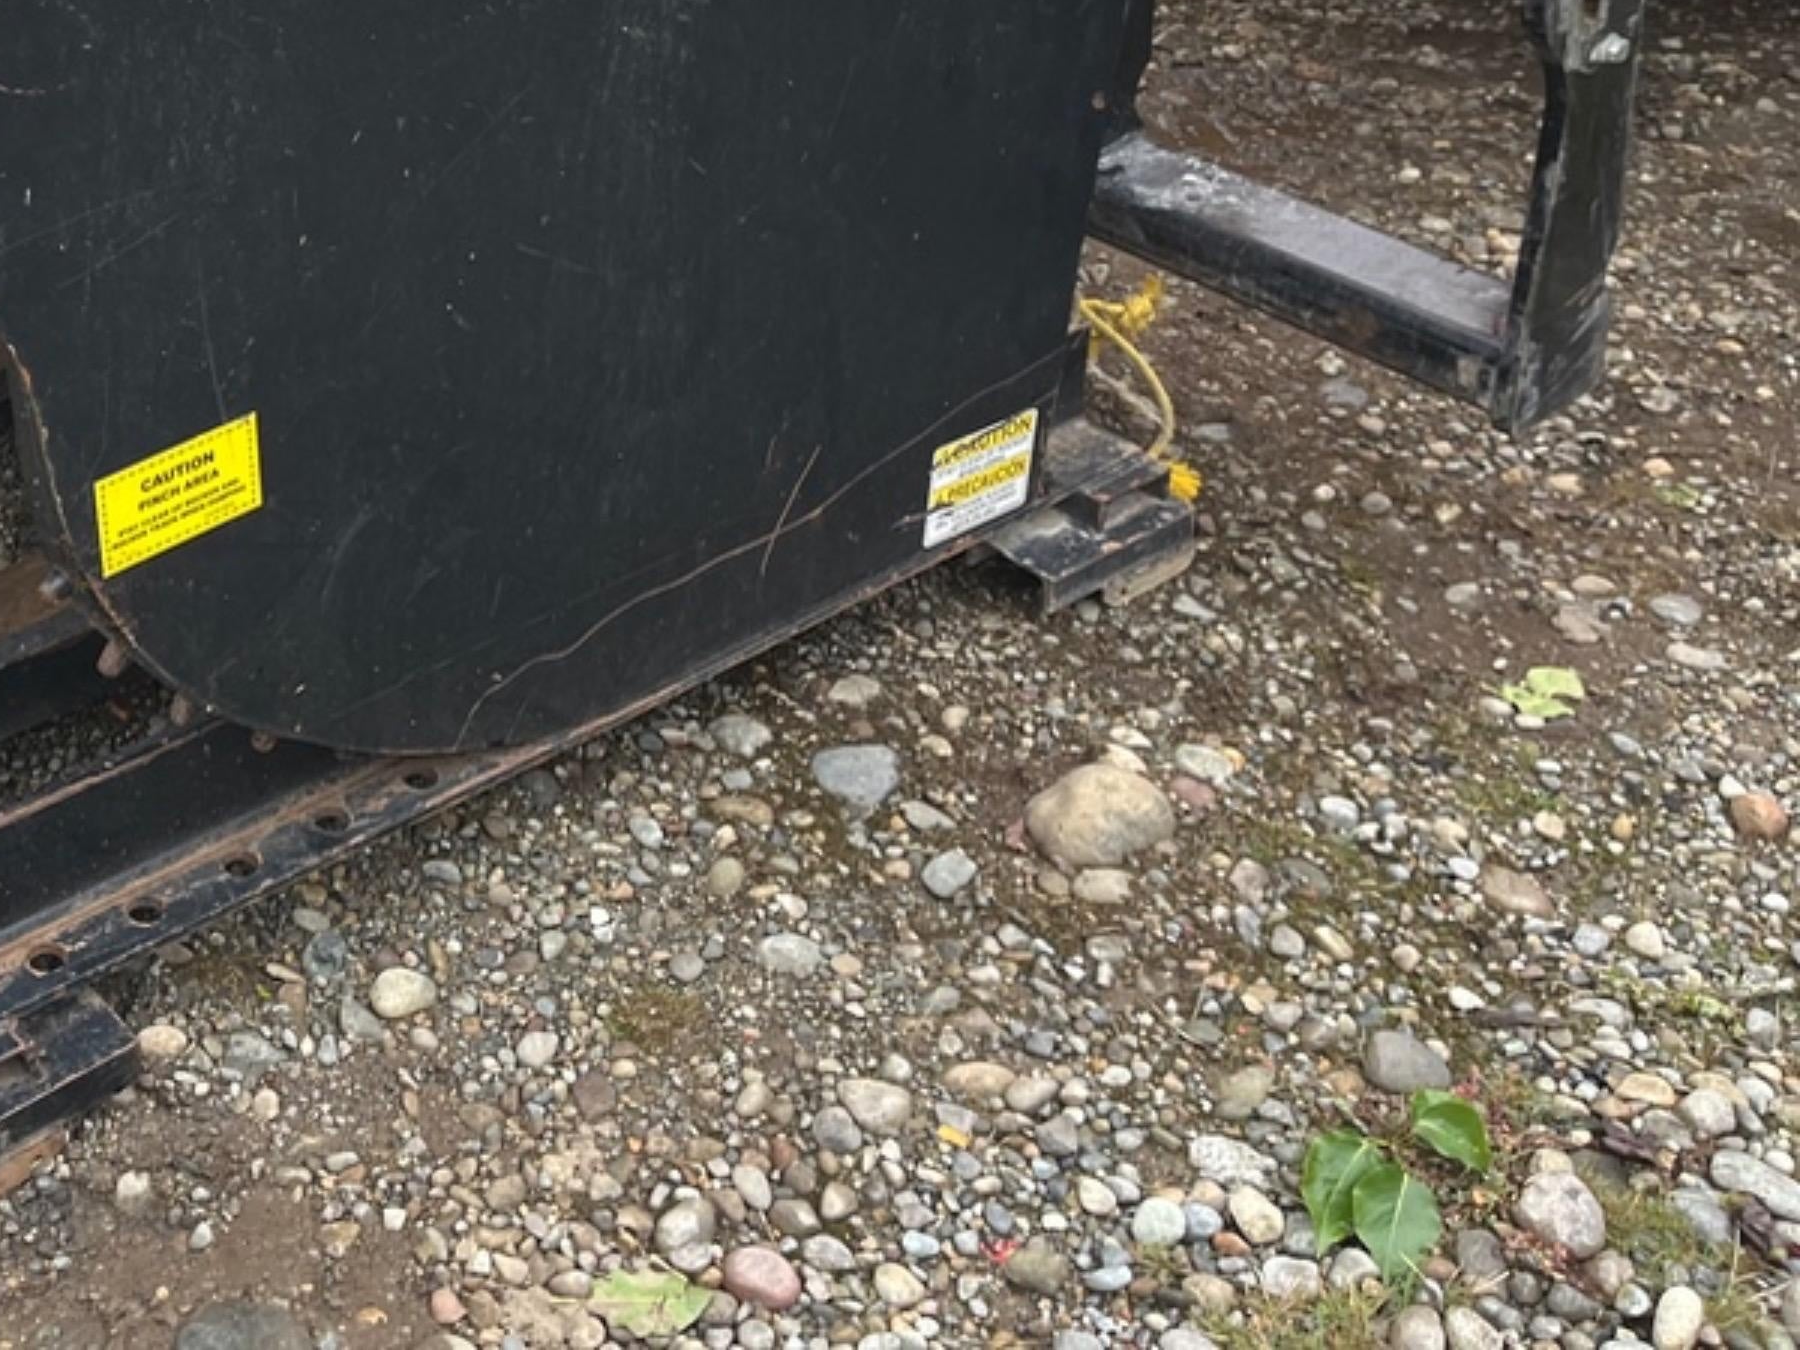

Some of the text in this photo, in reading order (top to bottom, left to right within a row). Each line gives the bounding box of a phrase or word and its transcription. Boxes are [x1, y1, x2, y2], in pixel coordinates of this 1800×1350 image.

[137, 486, 181, 513] PINCH
[183, 467, 221, 492] AREA
[139, 449, 216, 494] CAUTION
